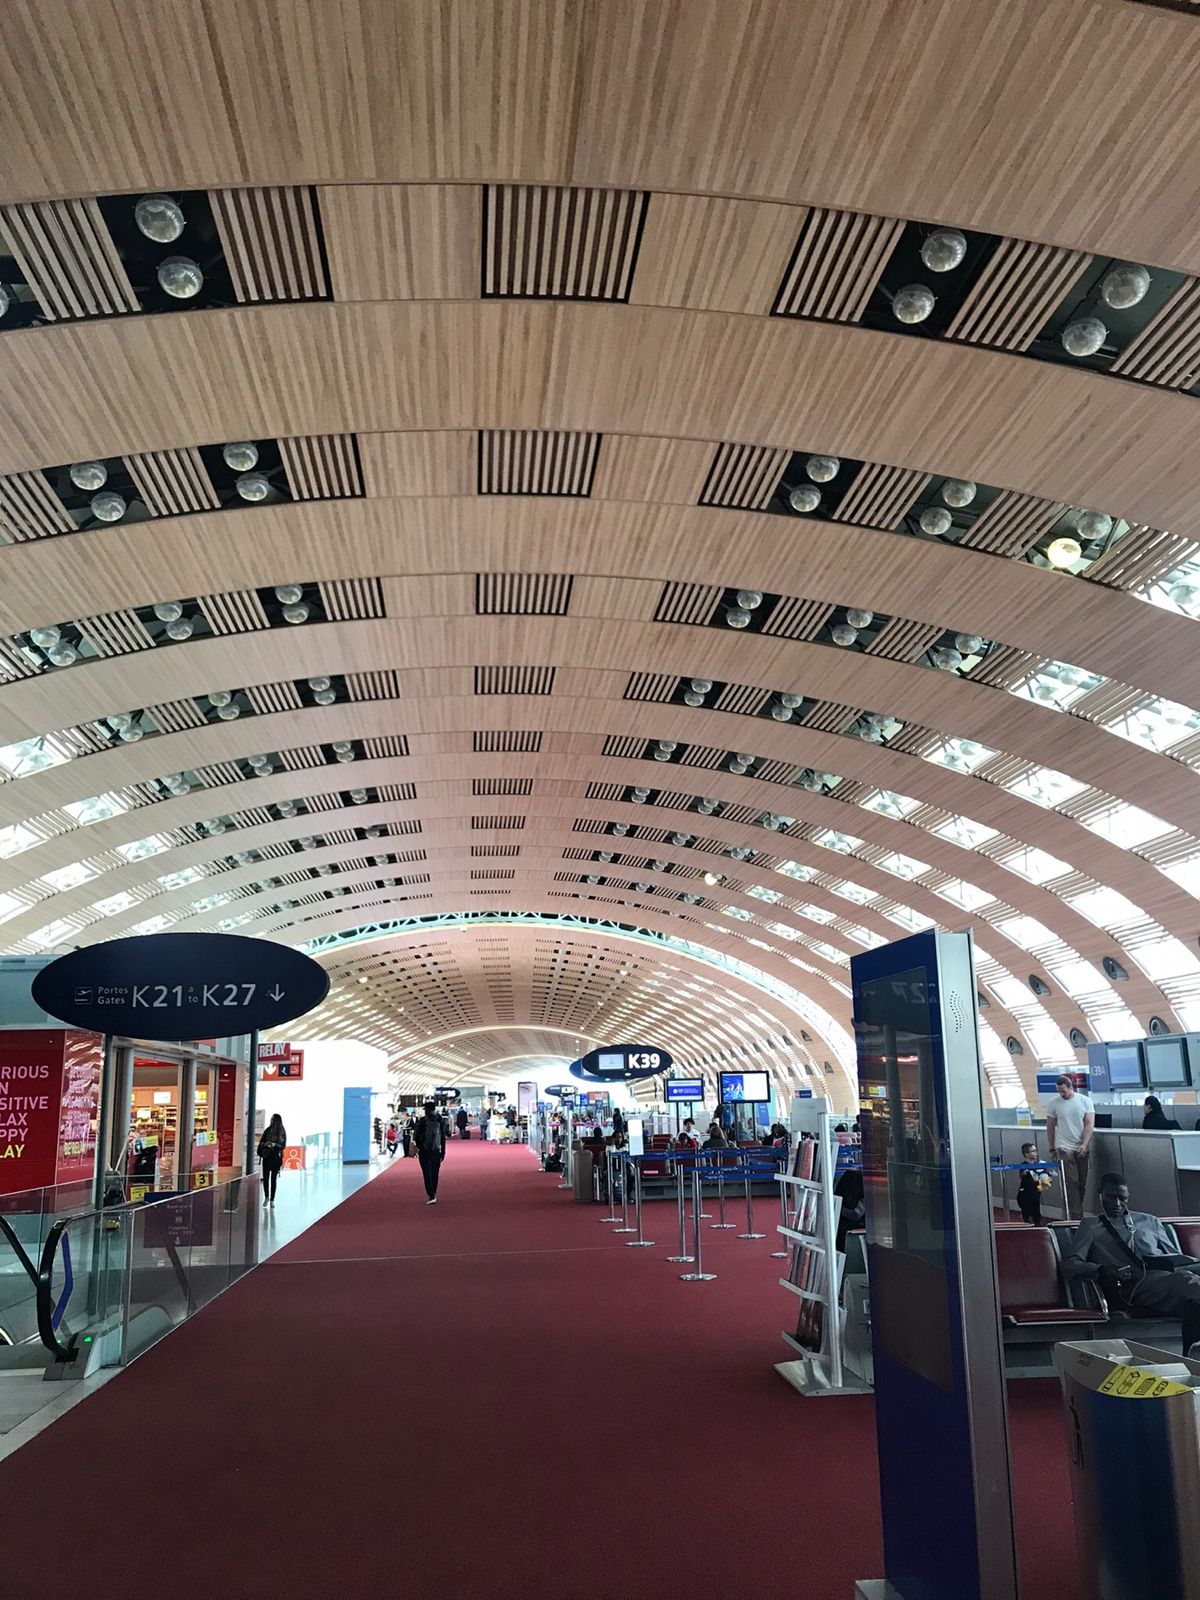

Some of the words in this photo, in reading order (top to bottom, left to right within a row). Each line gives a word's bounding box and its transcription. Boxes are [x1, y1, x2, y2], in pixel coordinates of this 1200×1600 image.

[97, 986, 129, 995] Portes
[132, 984, 183, 1008] K21
[203, 983, 256, 1007] K27
[97, 995, 126, 1005] Gates
[188, 994, 199, 1004] to
[260, 1043, 285, 1057] RELAY
[628, 1053, 661, 1069] K39
[1, 1065, 49, 1079] RIOUS
